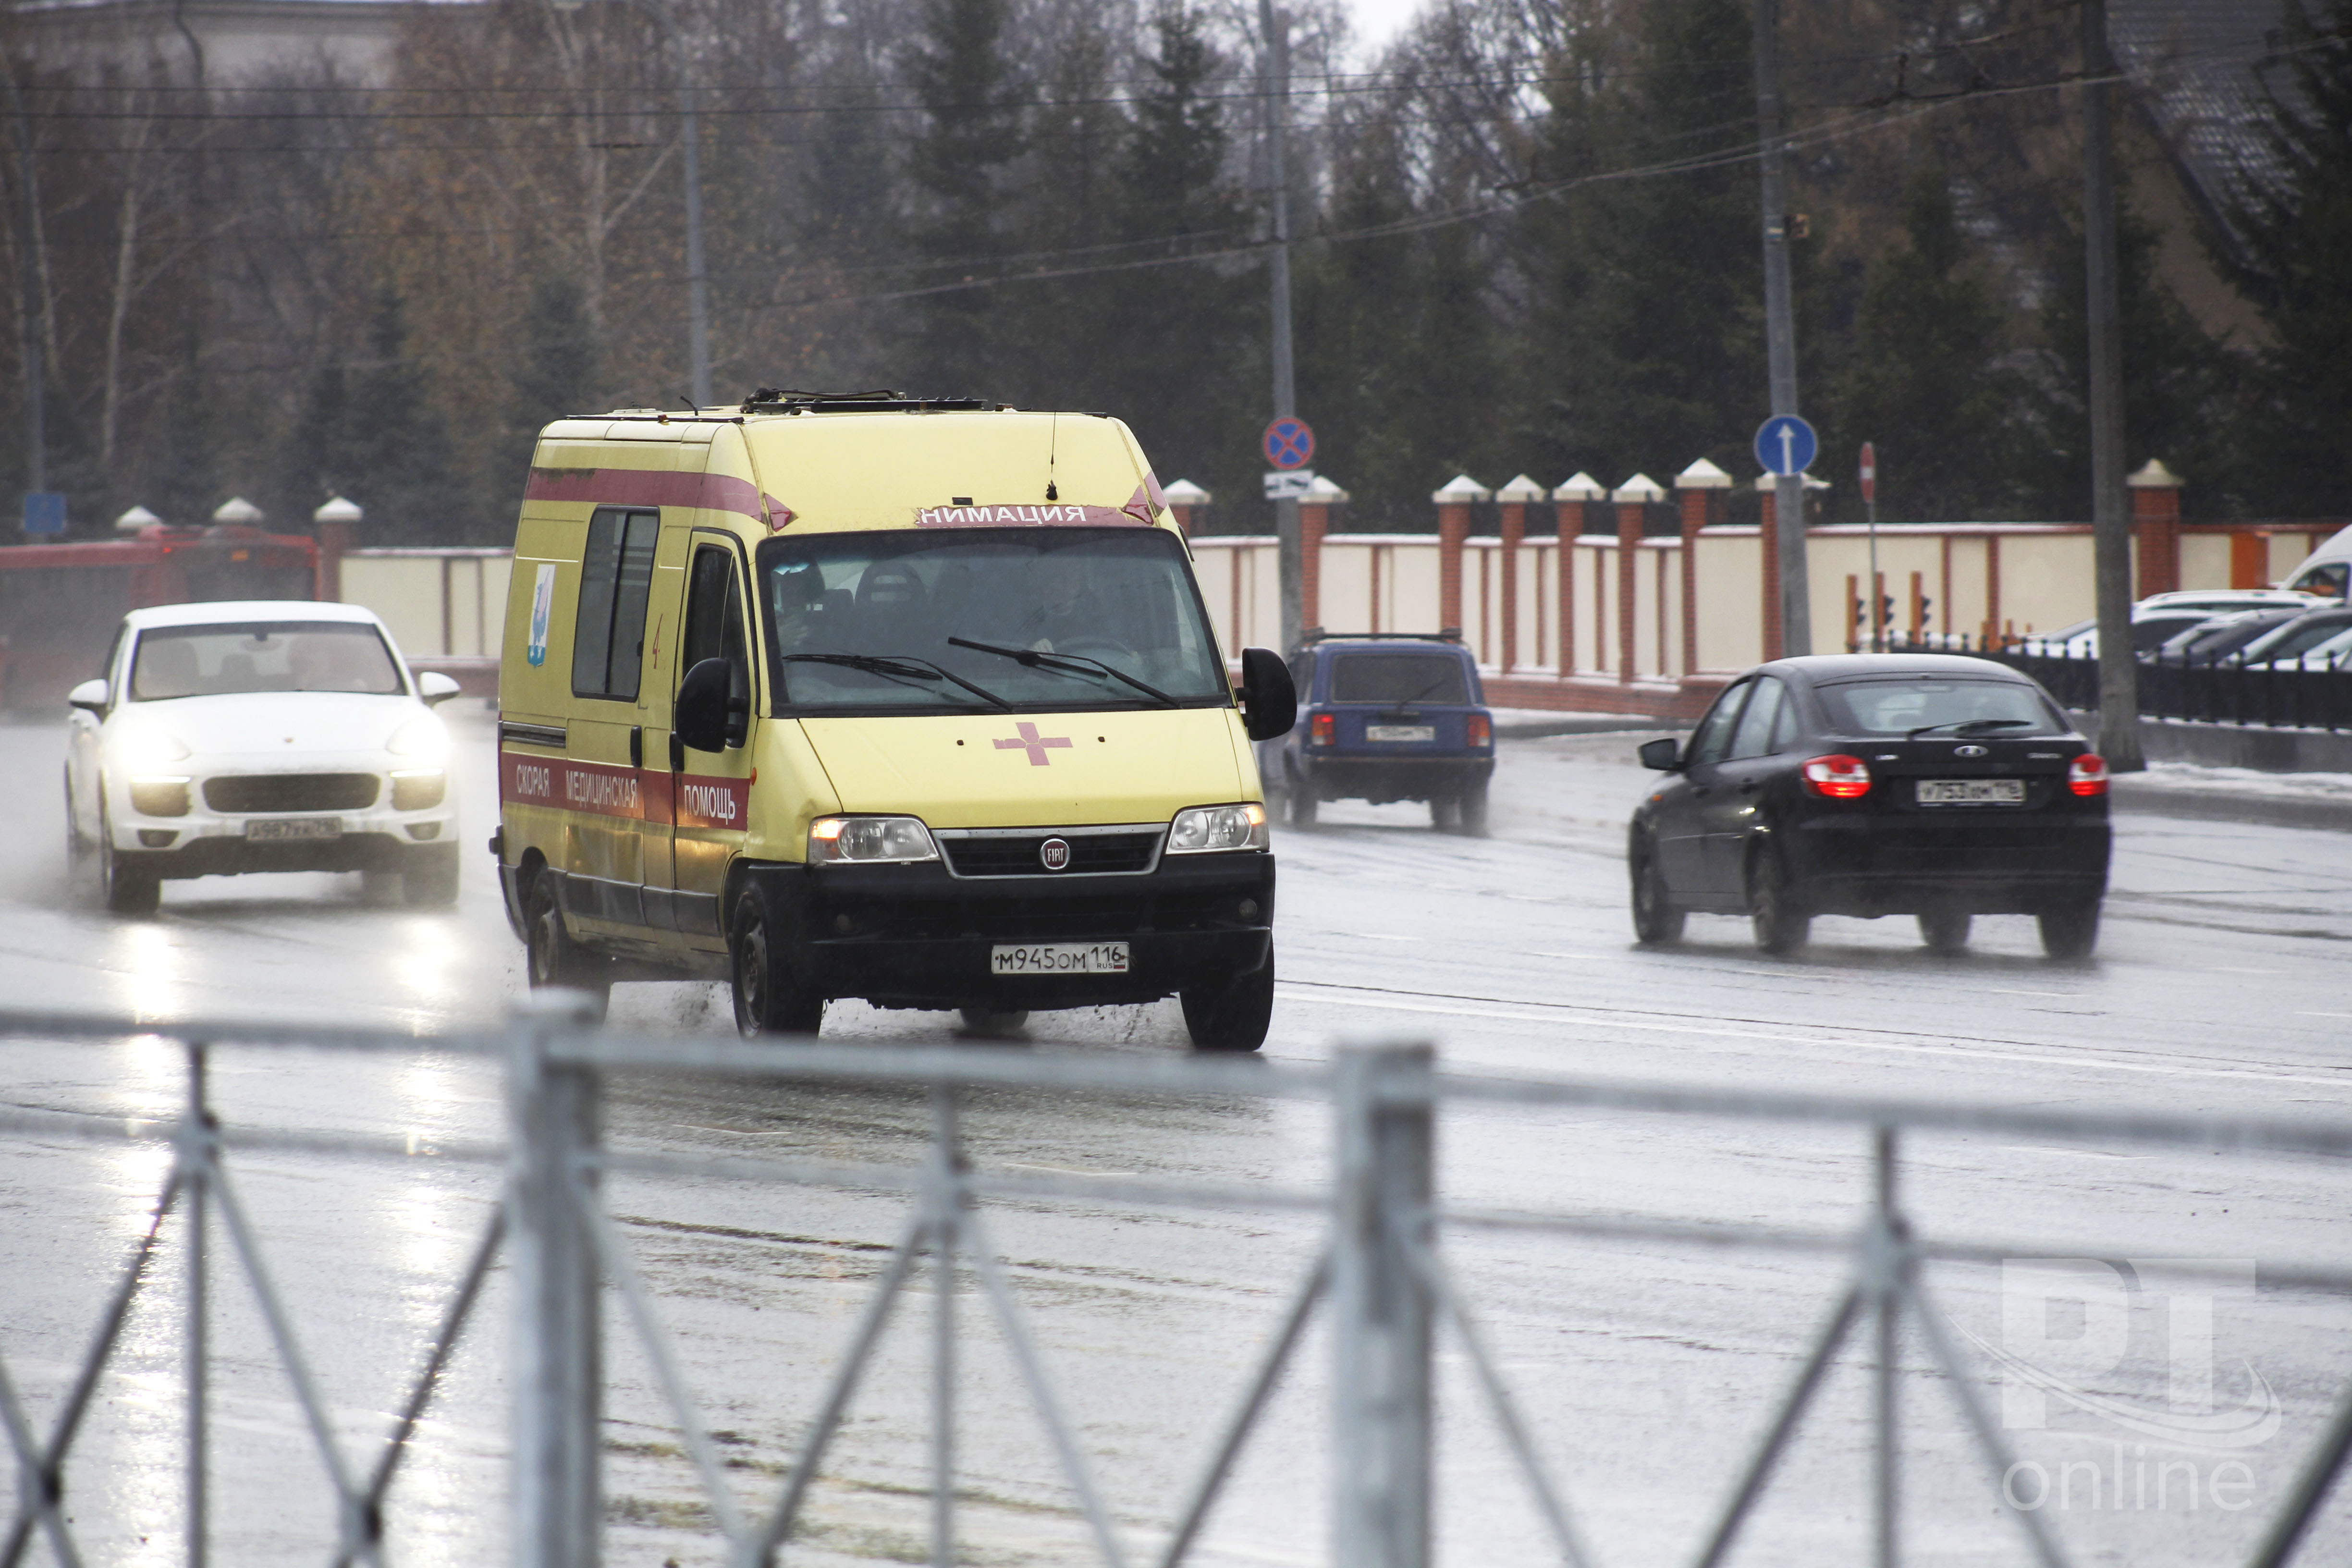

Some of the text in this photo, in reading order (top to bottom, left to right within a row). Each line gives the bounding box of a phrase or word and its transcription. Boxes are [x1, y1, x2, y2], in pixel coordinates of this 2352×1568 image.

[915, 506, 1087, 524] НИМАЦИЯ
[516, 764, 735, 824] СКОРАЯ МЕДИЦИНСКАЯ ПОМОЩЬ
[1047, 848, 1065, 862] FIAT
[1090, 946, 1120, 961] 116
